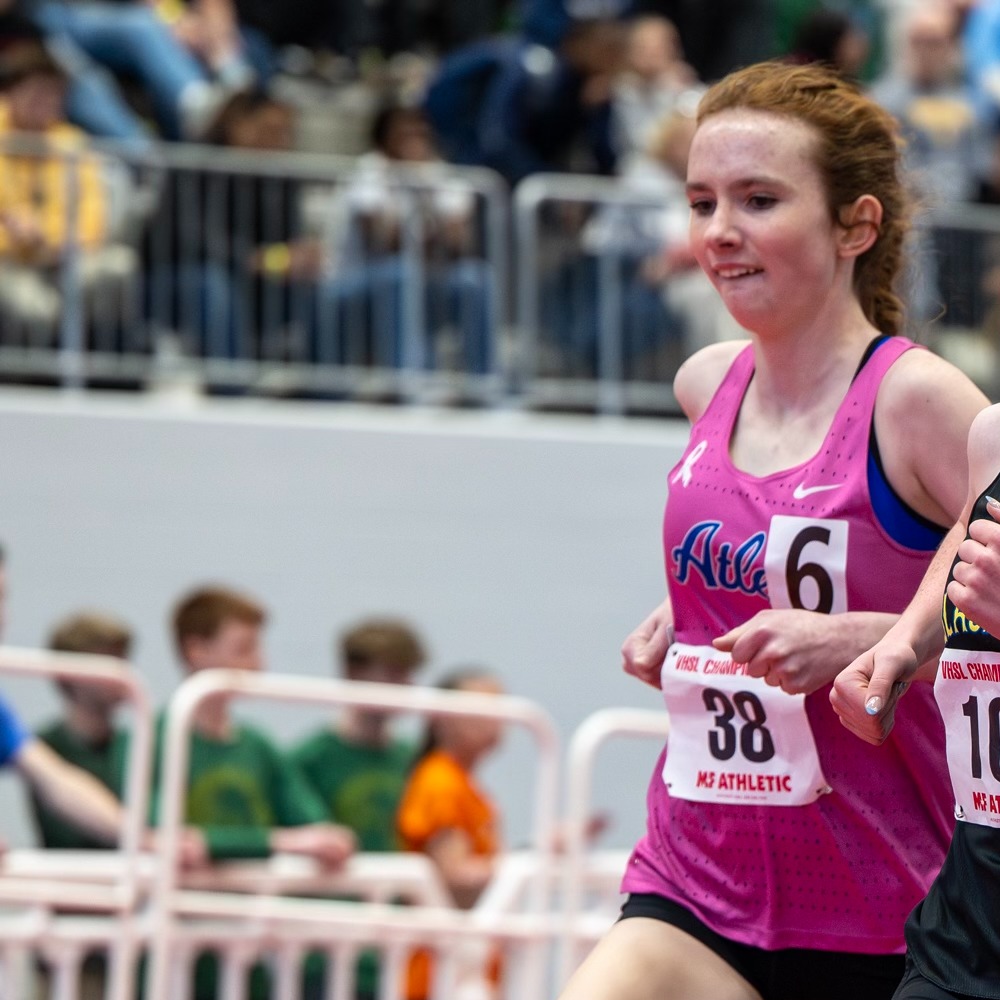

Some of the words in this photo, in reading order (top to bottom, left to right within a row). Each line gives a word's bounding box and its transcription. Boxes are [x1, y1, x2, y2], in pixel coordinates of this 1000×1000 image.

[785, 526, 834, 615] 6
[676, 655, 699, 673] VHSL
[941, 661, 968, 680] VHSL
[701, 687, 775, 763] 38
[718, 772, 792, 793] ATHLETIC
